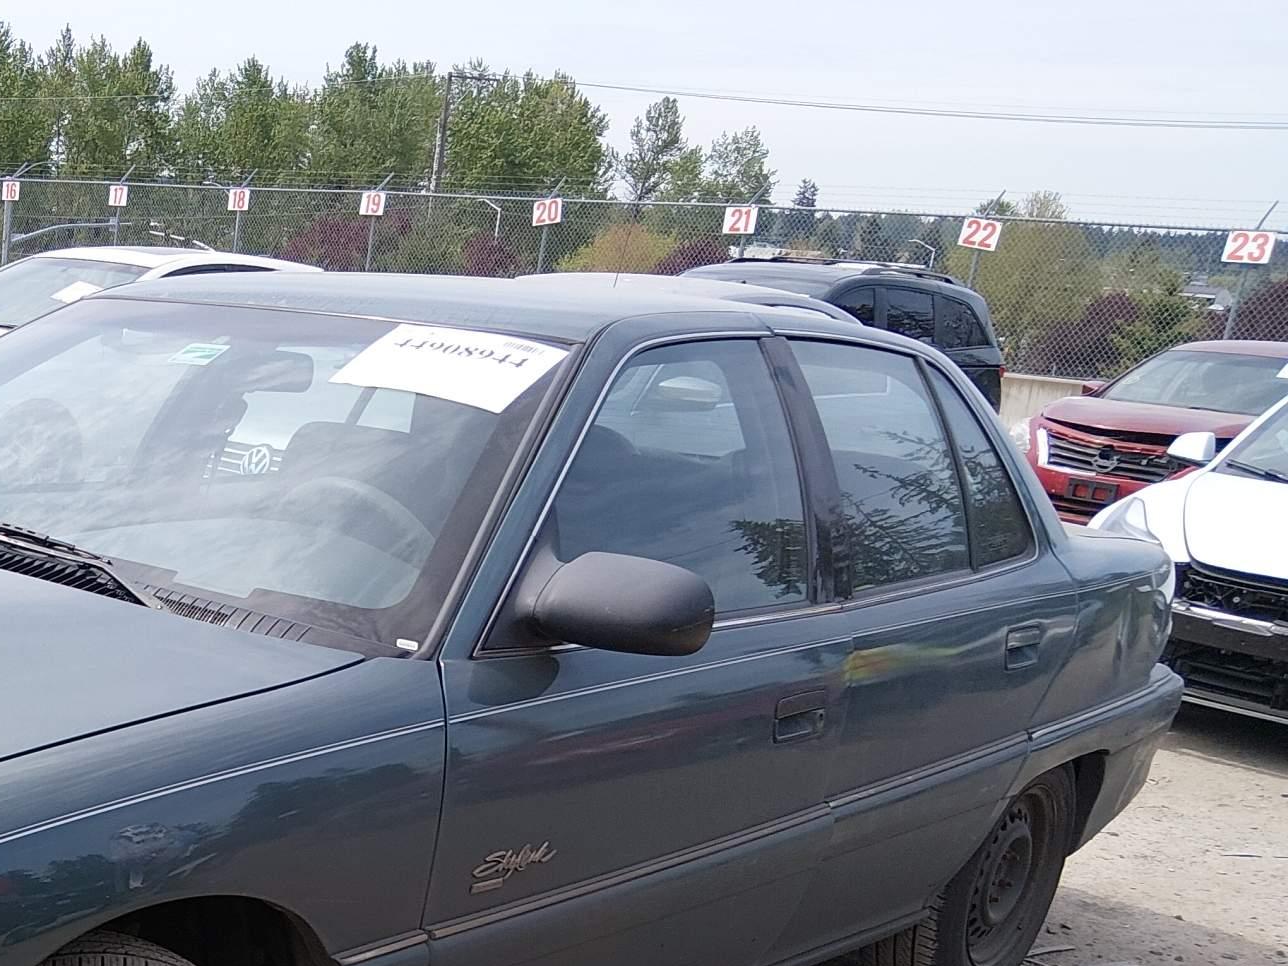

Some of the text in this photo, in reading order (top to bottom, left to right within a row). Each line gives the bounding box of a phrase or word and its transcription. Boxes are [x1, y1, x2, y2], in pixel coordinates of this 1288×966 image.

[6, 182, 17, 200] 16
[114, 187, 124, 204] 17
[233, 190, 245, 209] 18
[365, 193, 381, 213] 19
[536, 200, 558, 224] 20
[728, 208, 752, 232] 21
[962, 219, 997, 248] 22
[1226, 232, 1270, 262] 23
[394, 337, 529, 368] 44908944
